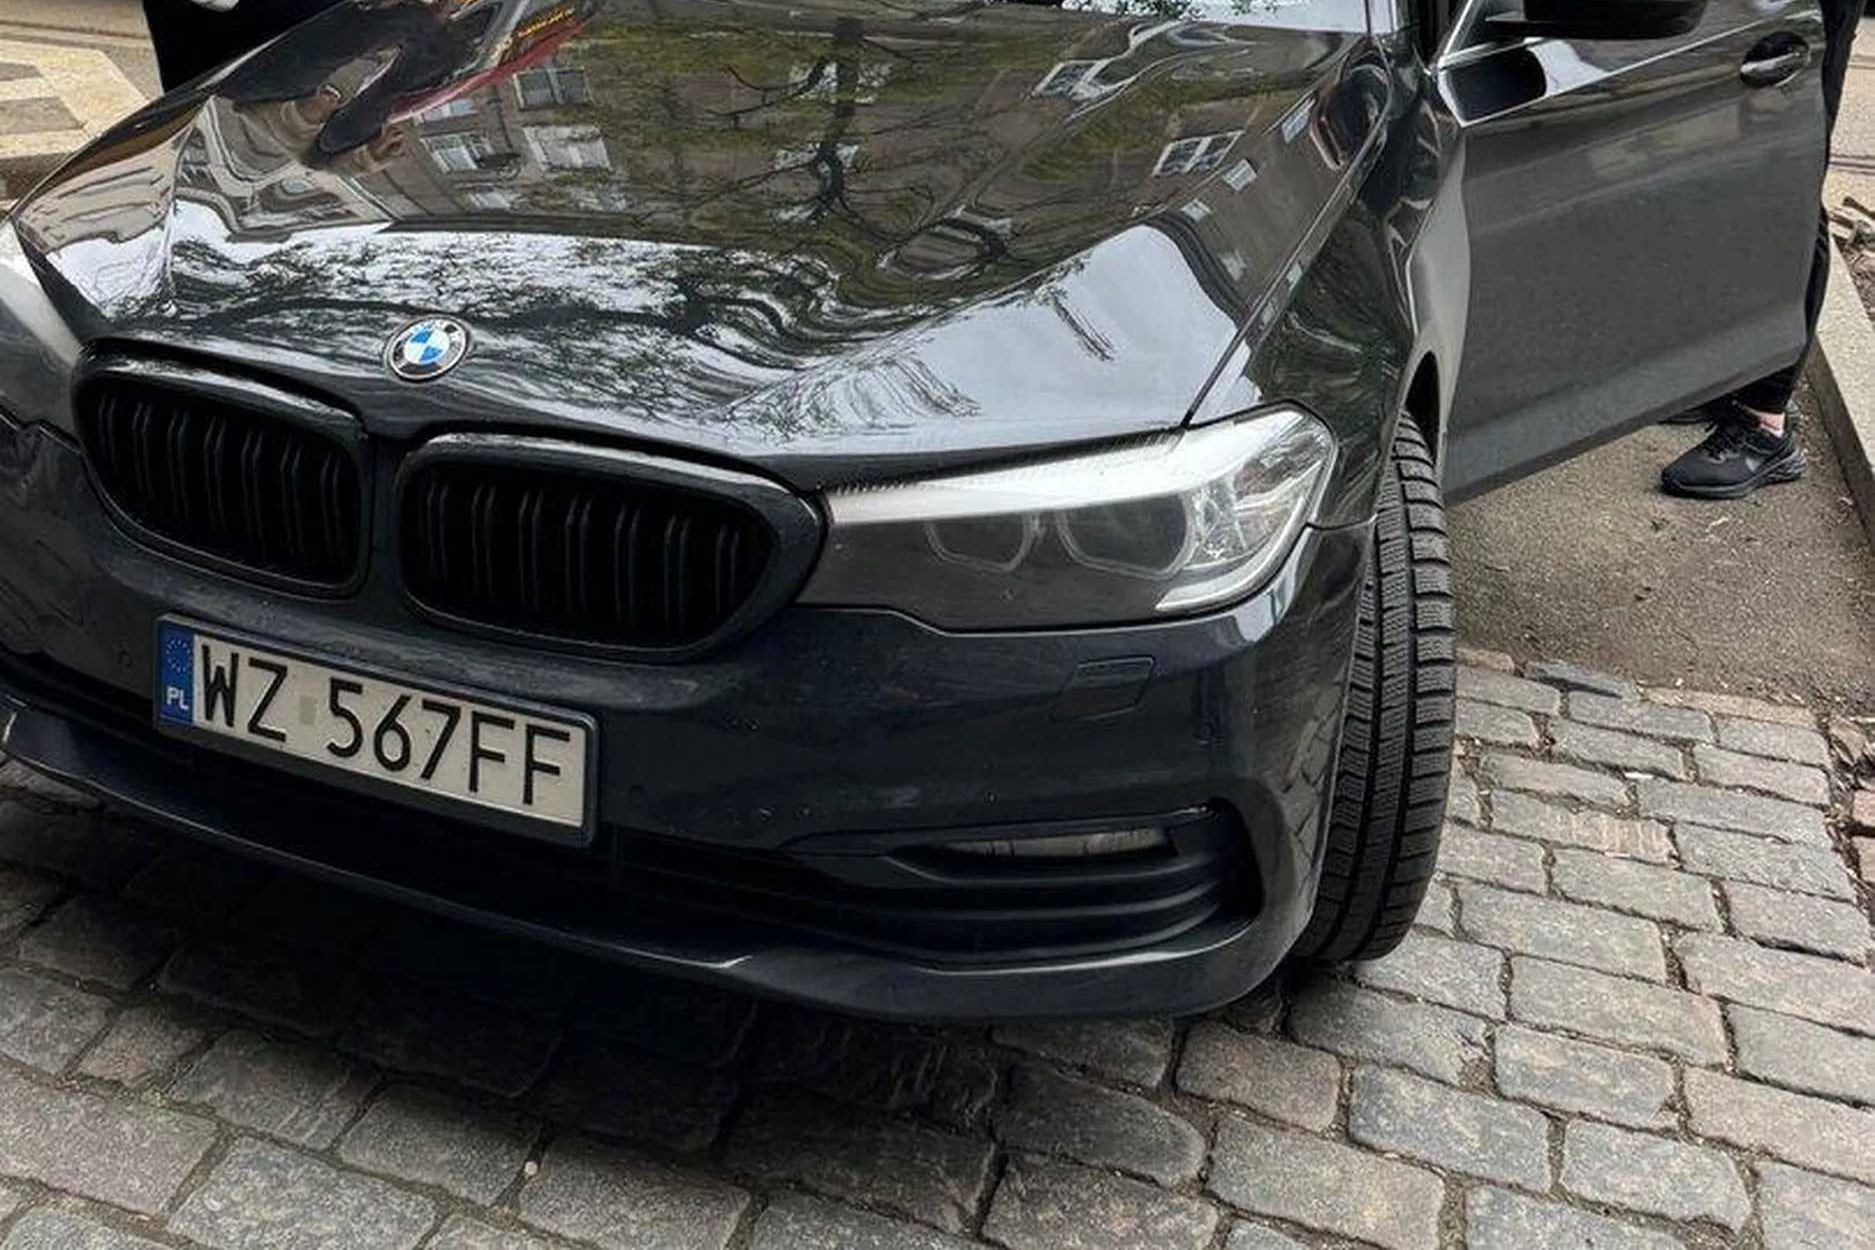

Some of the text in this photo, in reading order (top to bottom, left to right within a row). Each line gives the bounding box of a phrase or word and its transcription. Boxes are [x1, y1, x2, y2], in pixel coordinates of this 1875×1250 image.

[166, 686, 190, 711] PL
[202, 644, 571, 806] WZ 567FF
